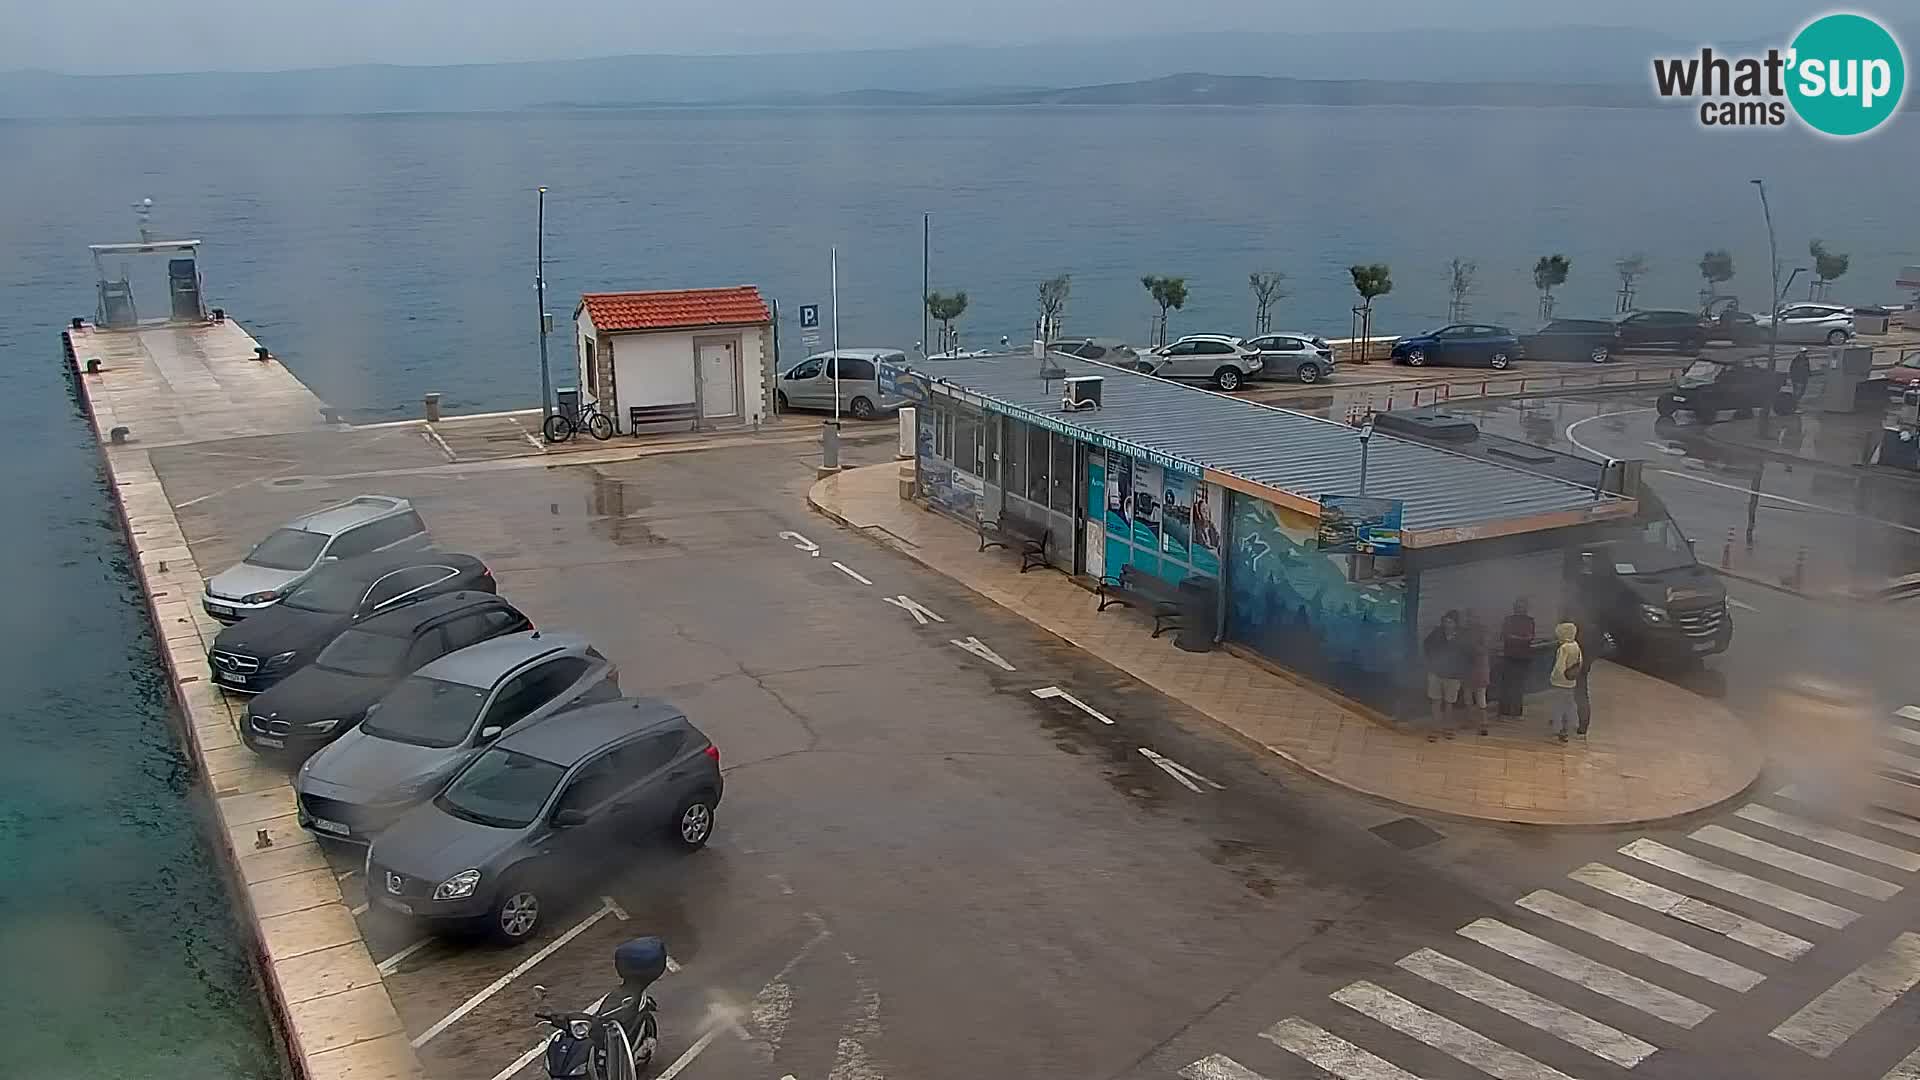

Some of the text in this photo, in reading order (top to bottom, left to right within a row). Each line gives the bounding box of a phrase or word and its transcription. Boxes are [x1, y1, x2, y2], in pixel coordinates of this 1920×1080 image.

[804, 308, 814, 325] P
[1065, 425, 1093, 442] POSTAJA
[1102, 437, 1116, 450] BUS
[1118, 442, 1147, 459] STATION
[1149, 451, 1173, 468] TICKET
[1174, 460, 1200, 476] OFFICE
